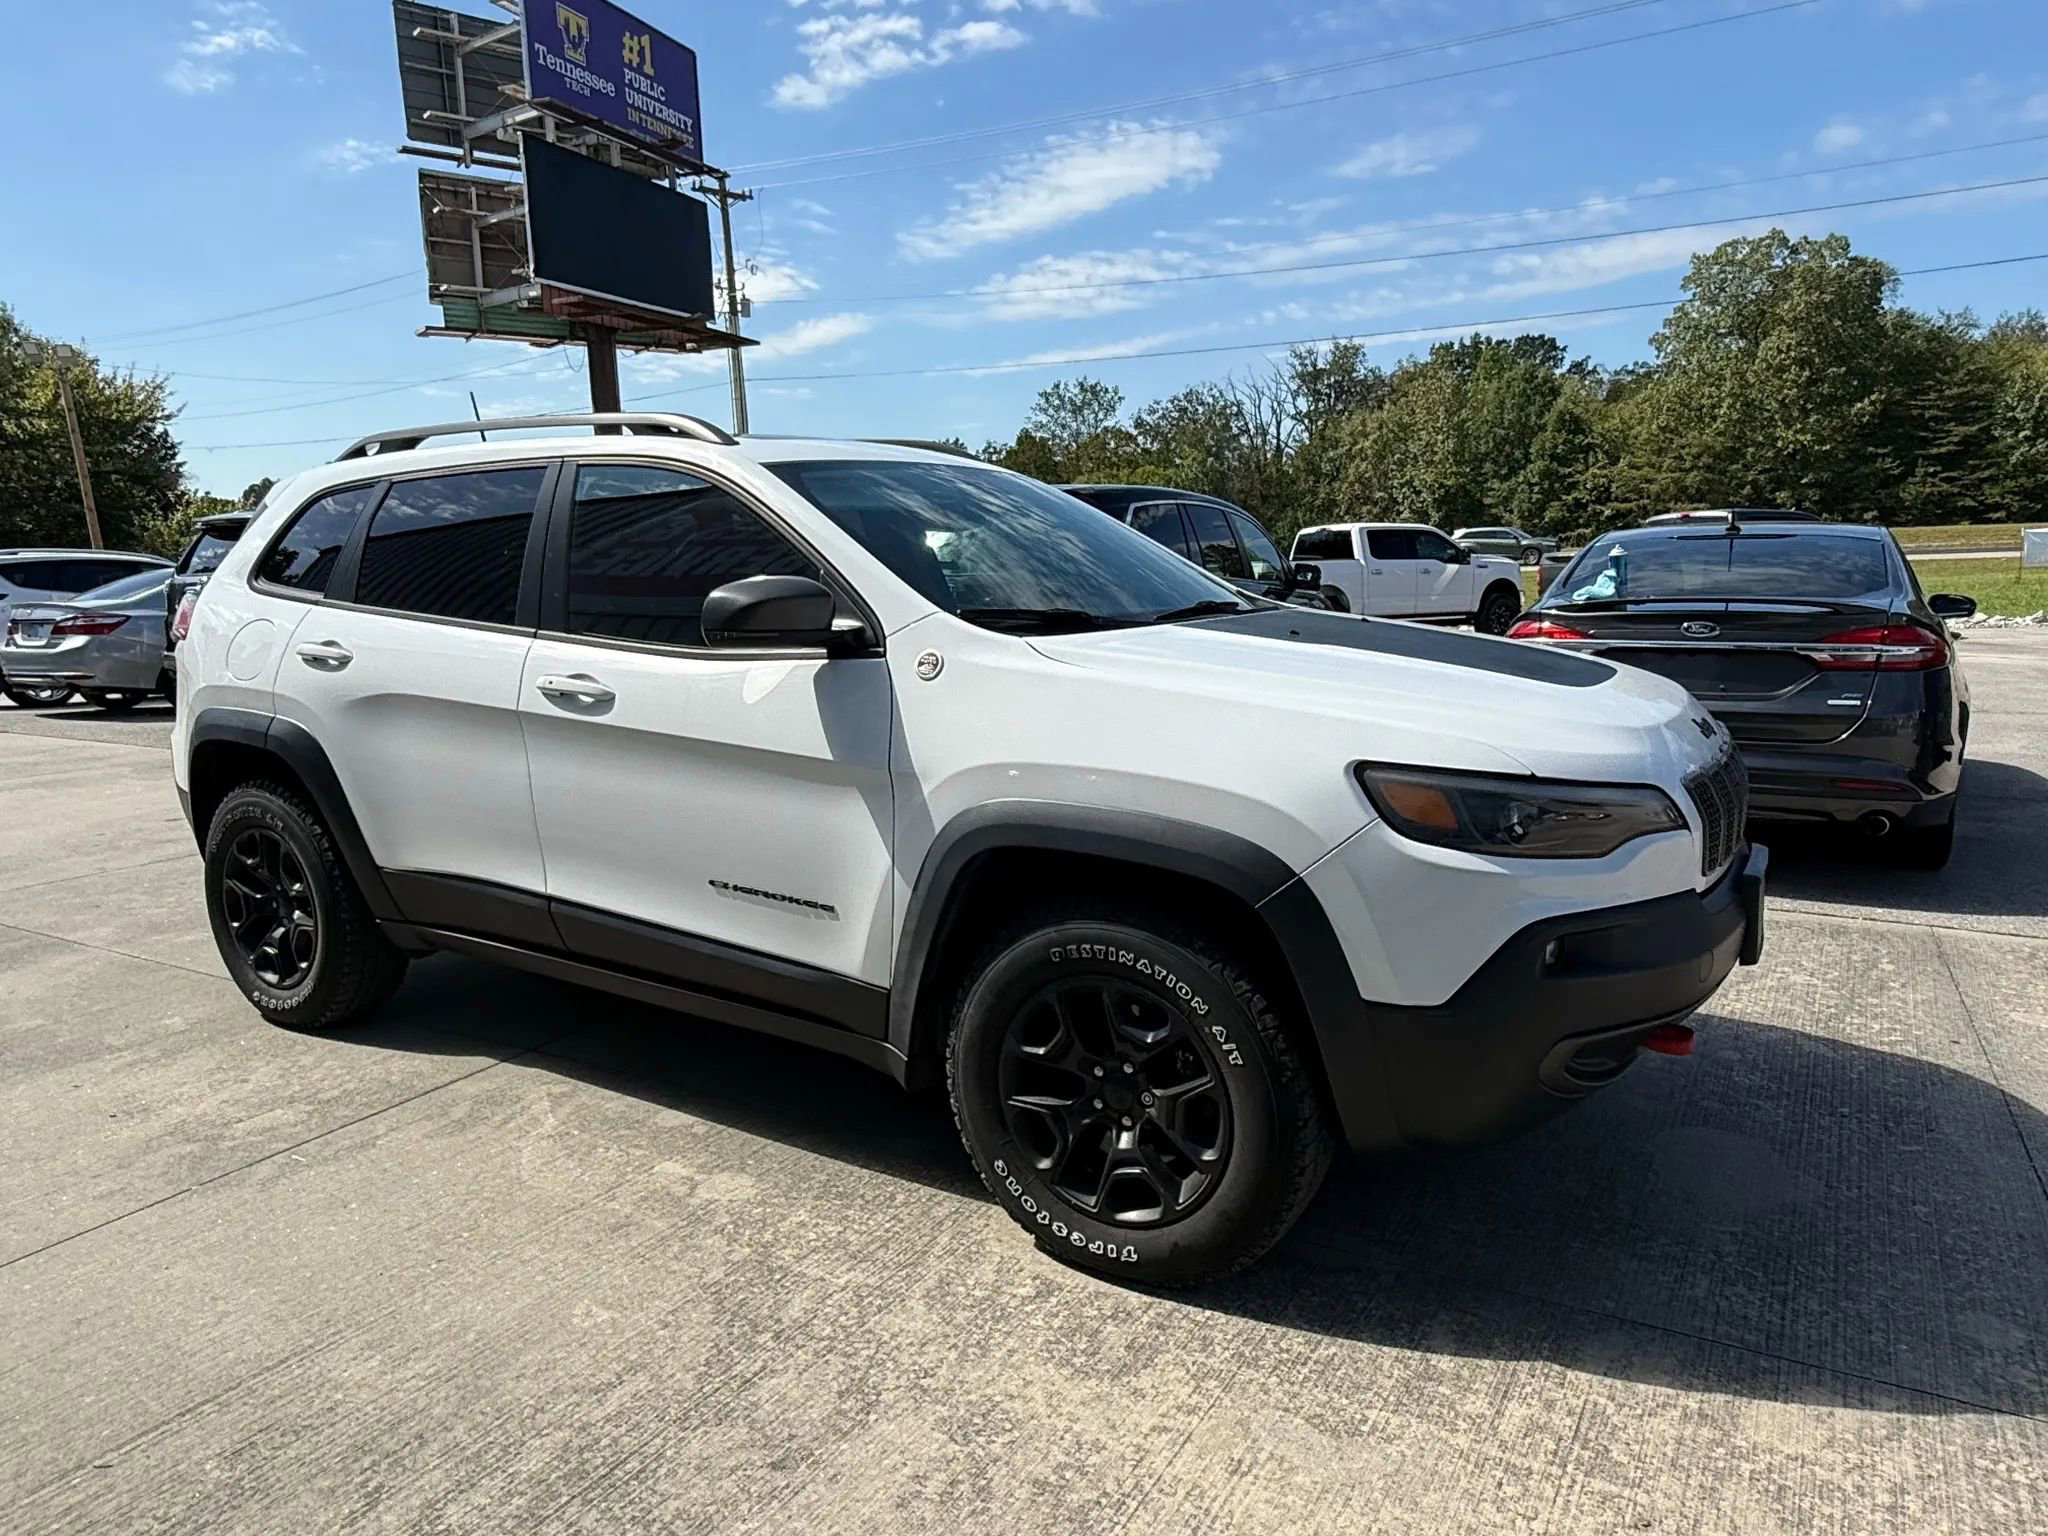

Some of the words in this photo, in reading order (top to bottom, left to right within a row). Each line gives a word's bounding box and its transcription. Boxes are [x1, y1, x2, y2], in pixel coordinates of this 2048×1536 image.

[534, 42, 616, 97] Tennessee
[622, 31, 654, 77] #1
[564, 77, 591, 97] TECH
[623, 68, 666, 101] PUBLIC
[625, 87, 693, 133] UNIVERSITY
[627, 107, 640, 125] IN
[1050, 944, 1208, 1014] DESTINATION
[1211, 1025, 1244, 1066] A/T
